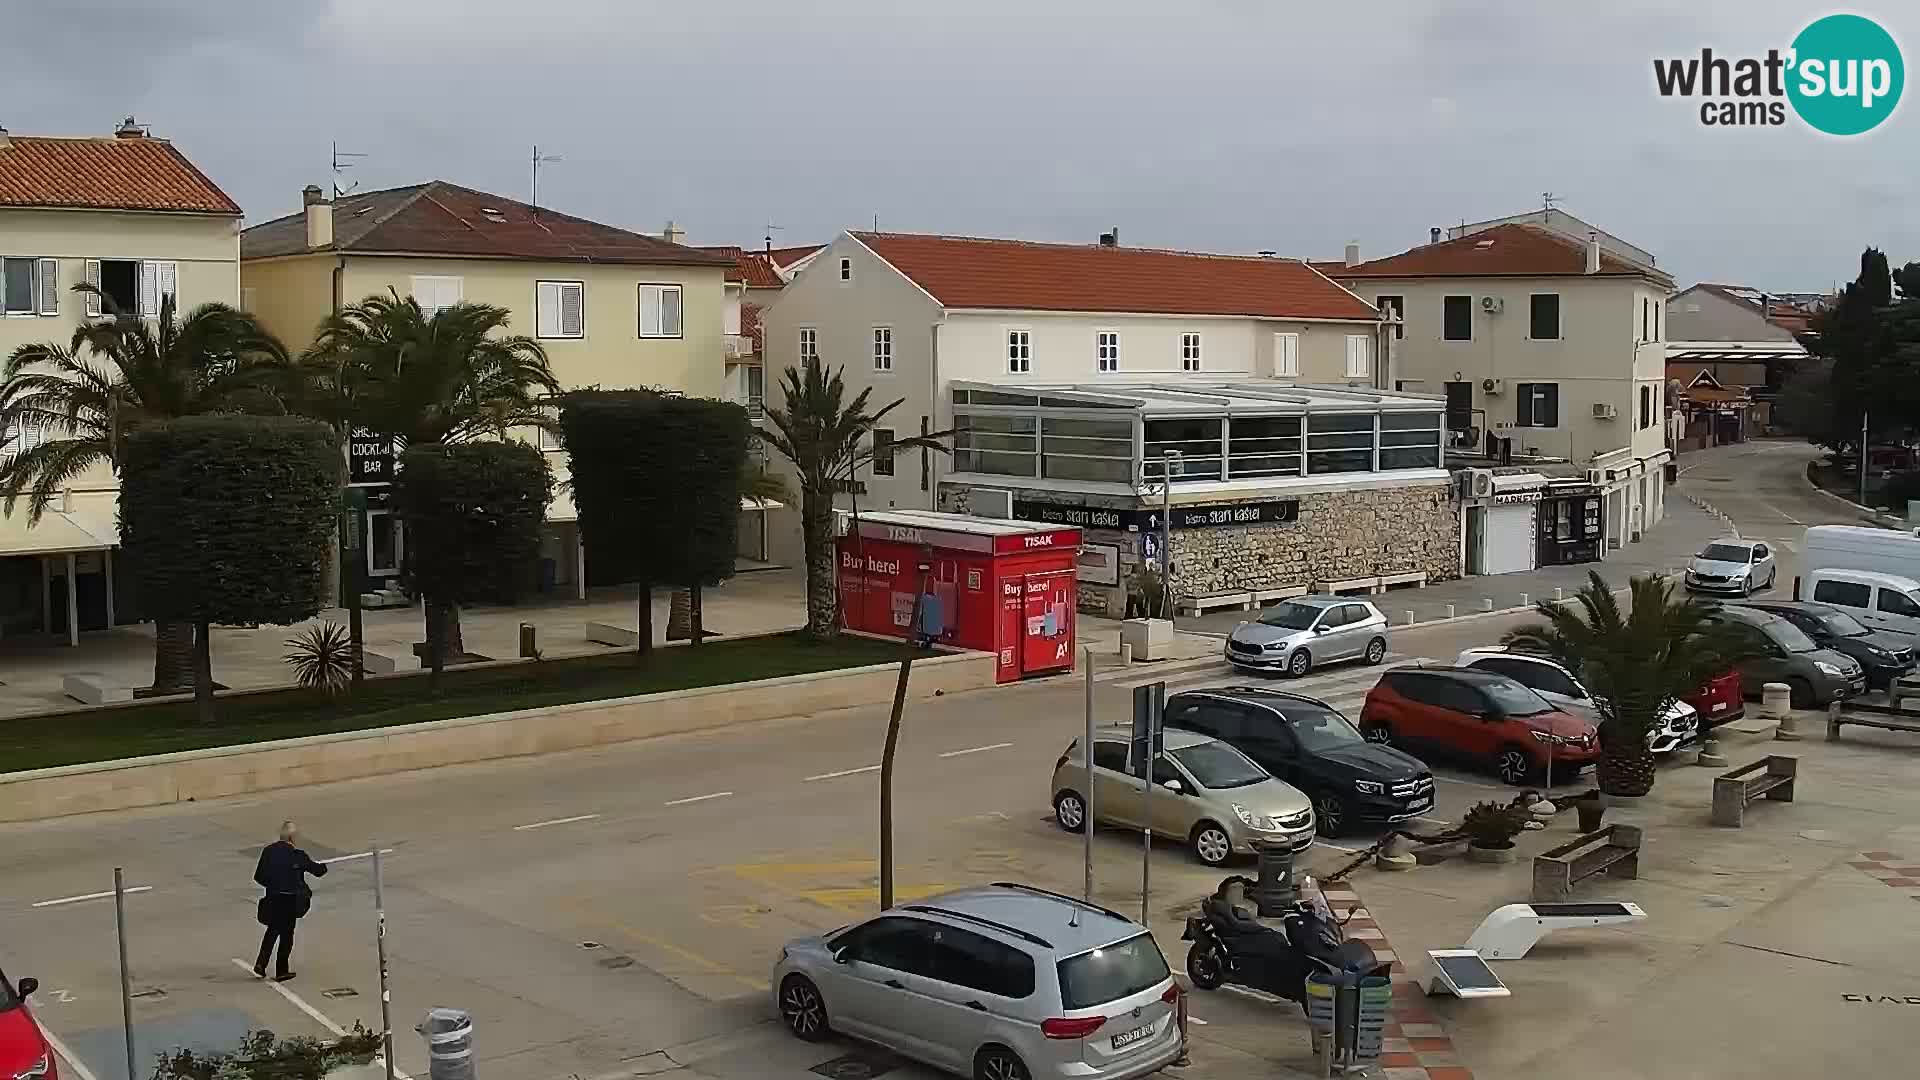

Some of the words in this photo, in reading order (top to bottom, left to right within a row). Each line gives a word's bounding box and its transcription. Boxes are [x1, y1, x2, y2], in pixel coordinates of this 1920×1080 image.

[352, 443, 392, 456] COCKTI
[364, 460, 381, 473] BAR
[1495, 493, 1535, 505] MARKET
[887, 526, 923, 543] TISAK
[1024, 534, 1053, 548] TISAK
[842, 551, 864, 570] Buy
[868, 554, 900, 576] here!
[1004, 583, 1022, 597] Buy
[1027, 579, 1050, 593] here!
[1055, 640, 1068, 660] A1
